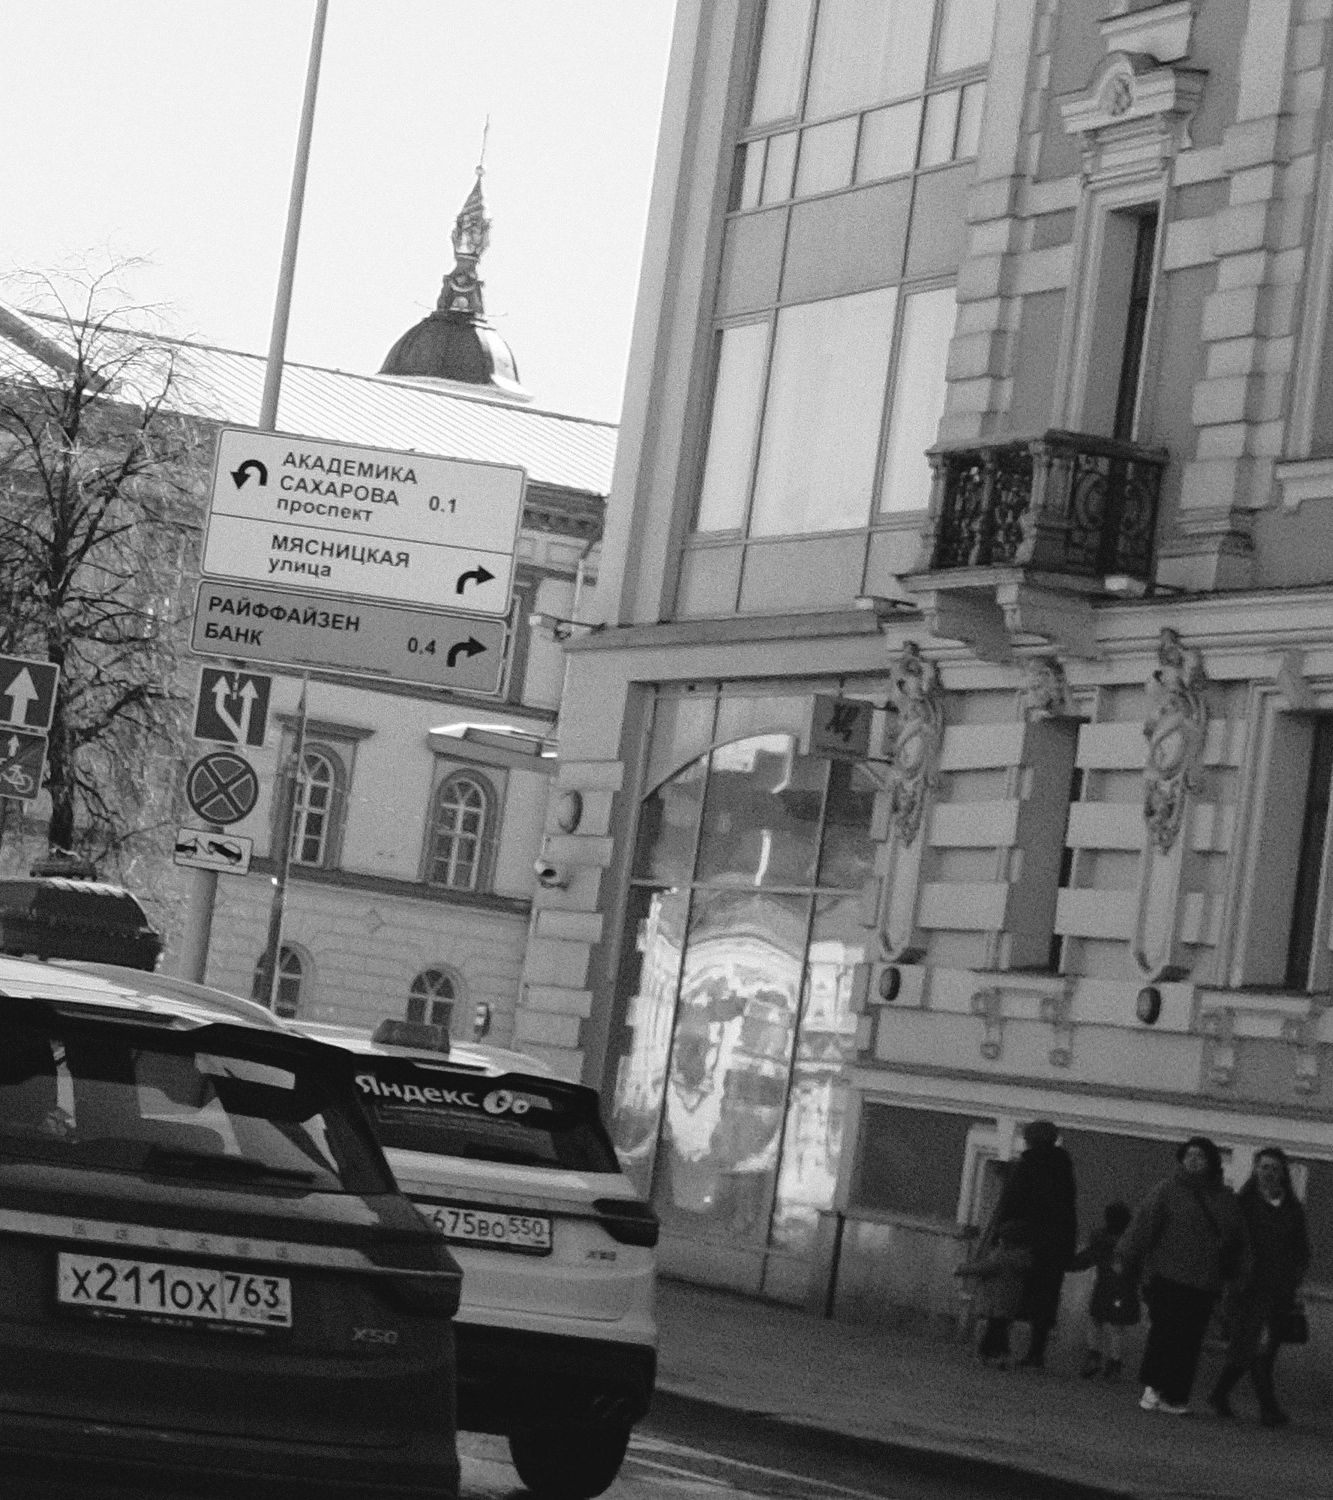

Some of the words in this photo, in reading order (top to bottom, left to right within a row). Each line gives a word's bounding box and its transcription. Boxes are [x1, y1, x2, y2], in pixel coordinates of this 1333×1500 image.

[282, 451, 418, 485] АКАДЕМИКА
[279, 475, 400, 506] САХАРОВА
[428, 495, 458, 514] 0.1
[276, 497, 373, 523] проспект
[271, 534, 411, 569] МЯСНИЦКАЯ
[268, 557, 332, 578] улица
[208, 594, 361, 632] РАЙФФАЙЗЕН
[204, 623, 263, 647] БАНК
[407, 636, 437, 656] 0.4
[354, 1074, 480, 1109] Яндекс
[427, 1208, 506, 1239] 675ВО
[508, 1217, 544, 1237] 550
[70, 1261, 218, 1314] Х211ОХ
[225, 1274, 281, 1308] 763
